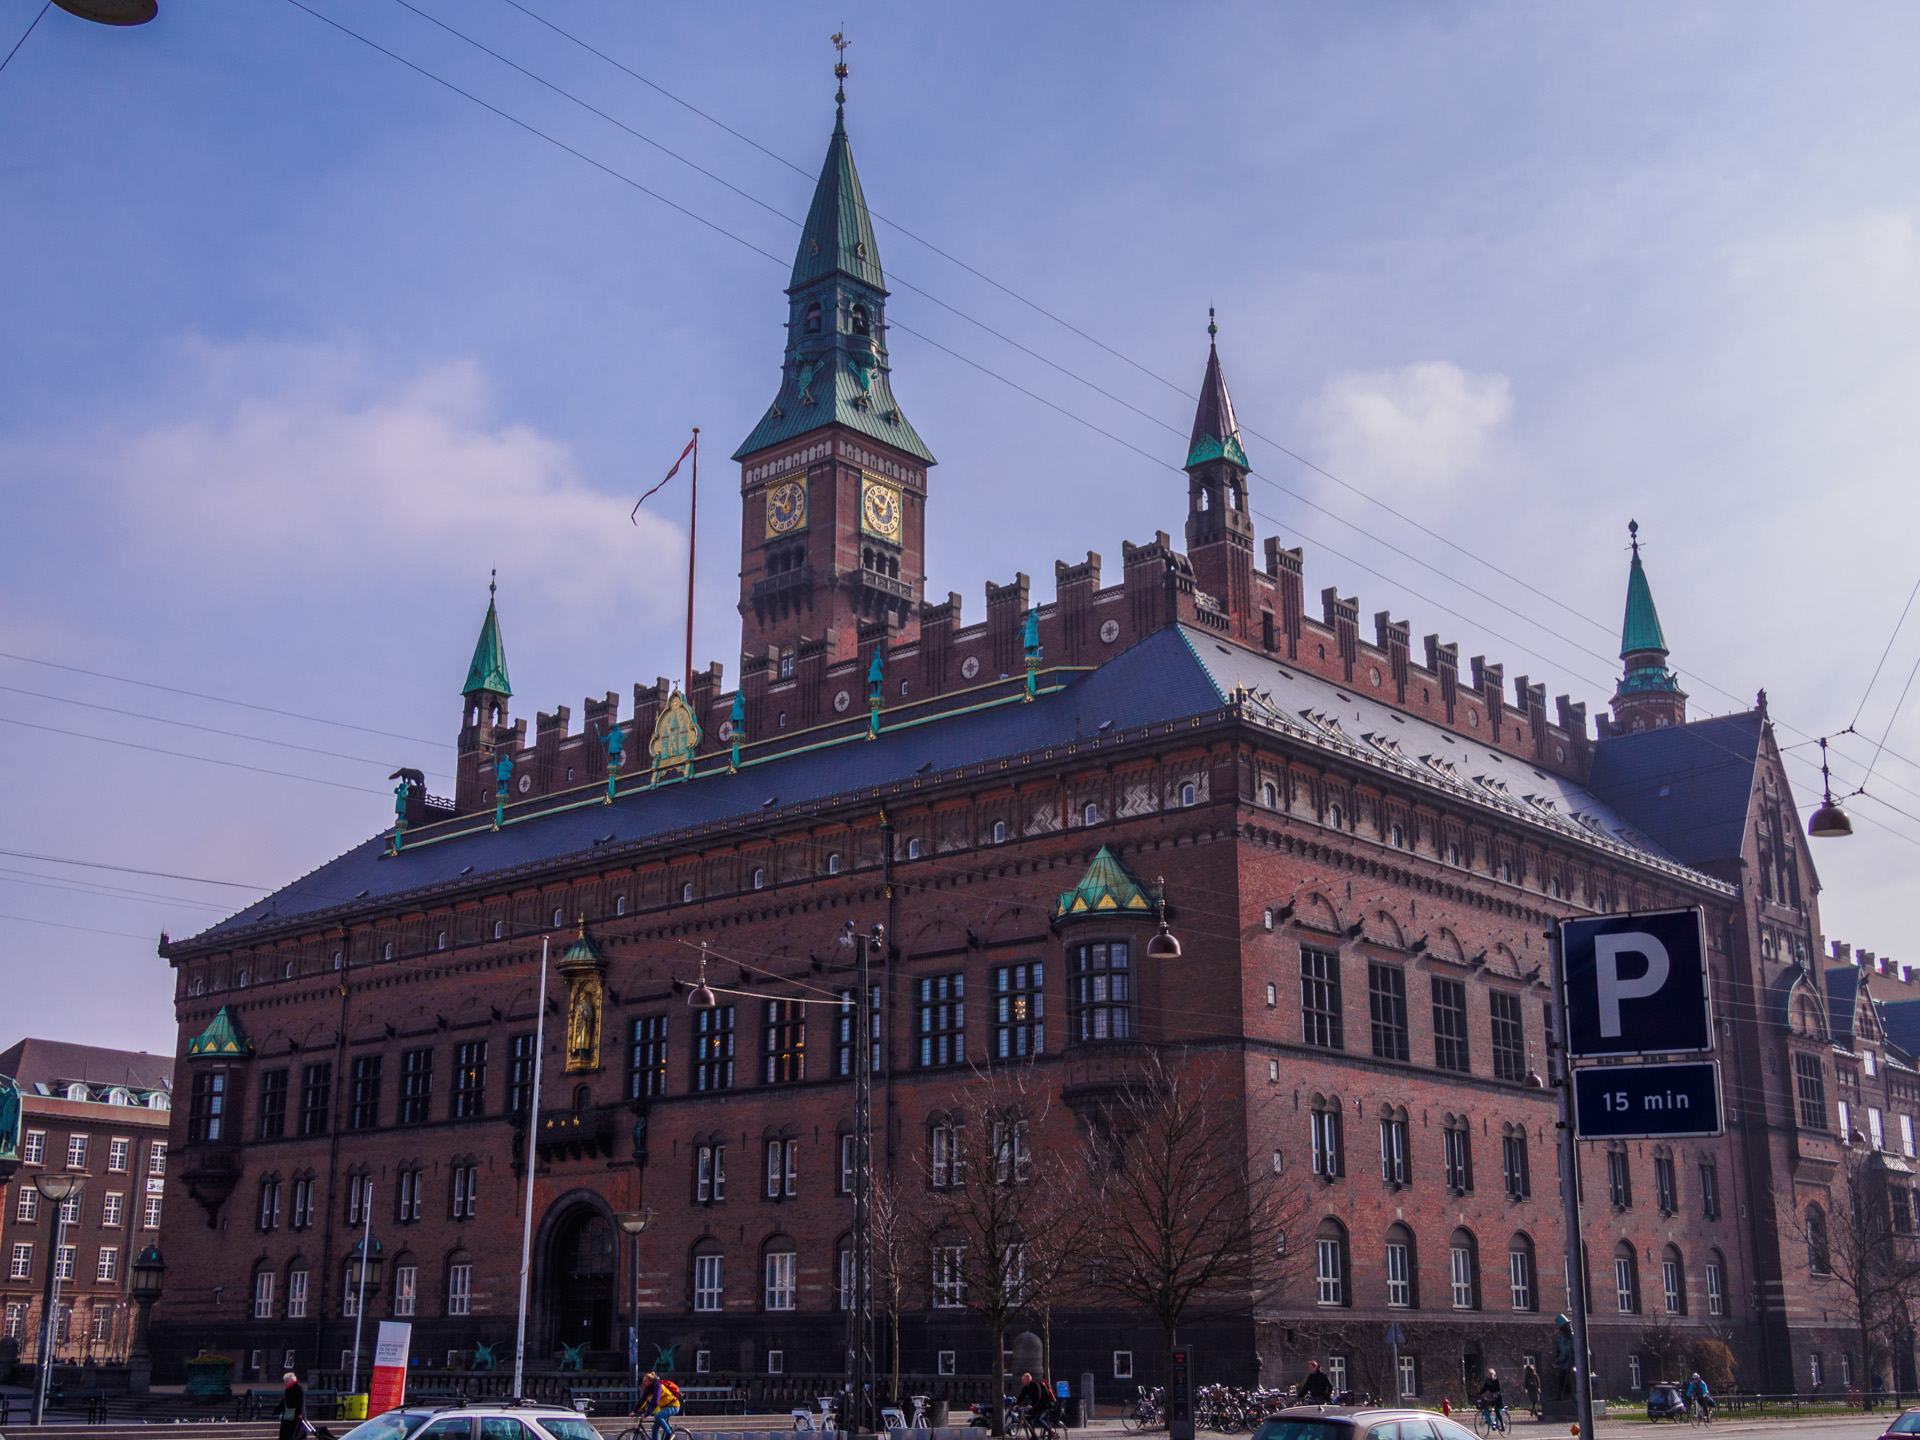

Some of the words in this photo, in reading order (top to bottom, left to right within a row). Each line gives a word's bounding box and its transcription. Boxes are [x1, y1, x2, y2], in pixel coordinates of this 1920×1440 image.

[1594, 931, 1670, 1038] P
[1602, 1091, 1630, 1112] 15
[1643, 1089, 1690, 1111] min
